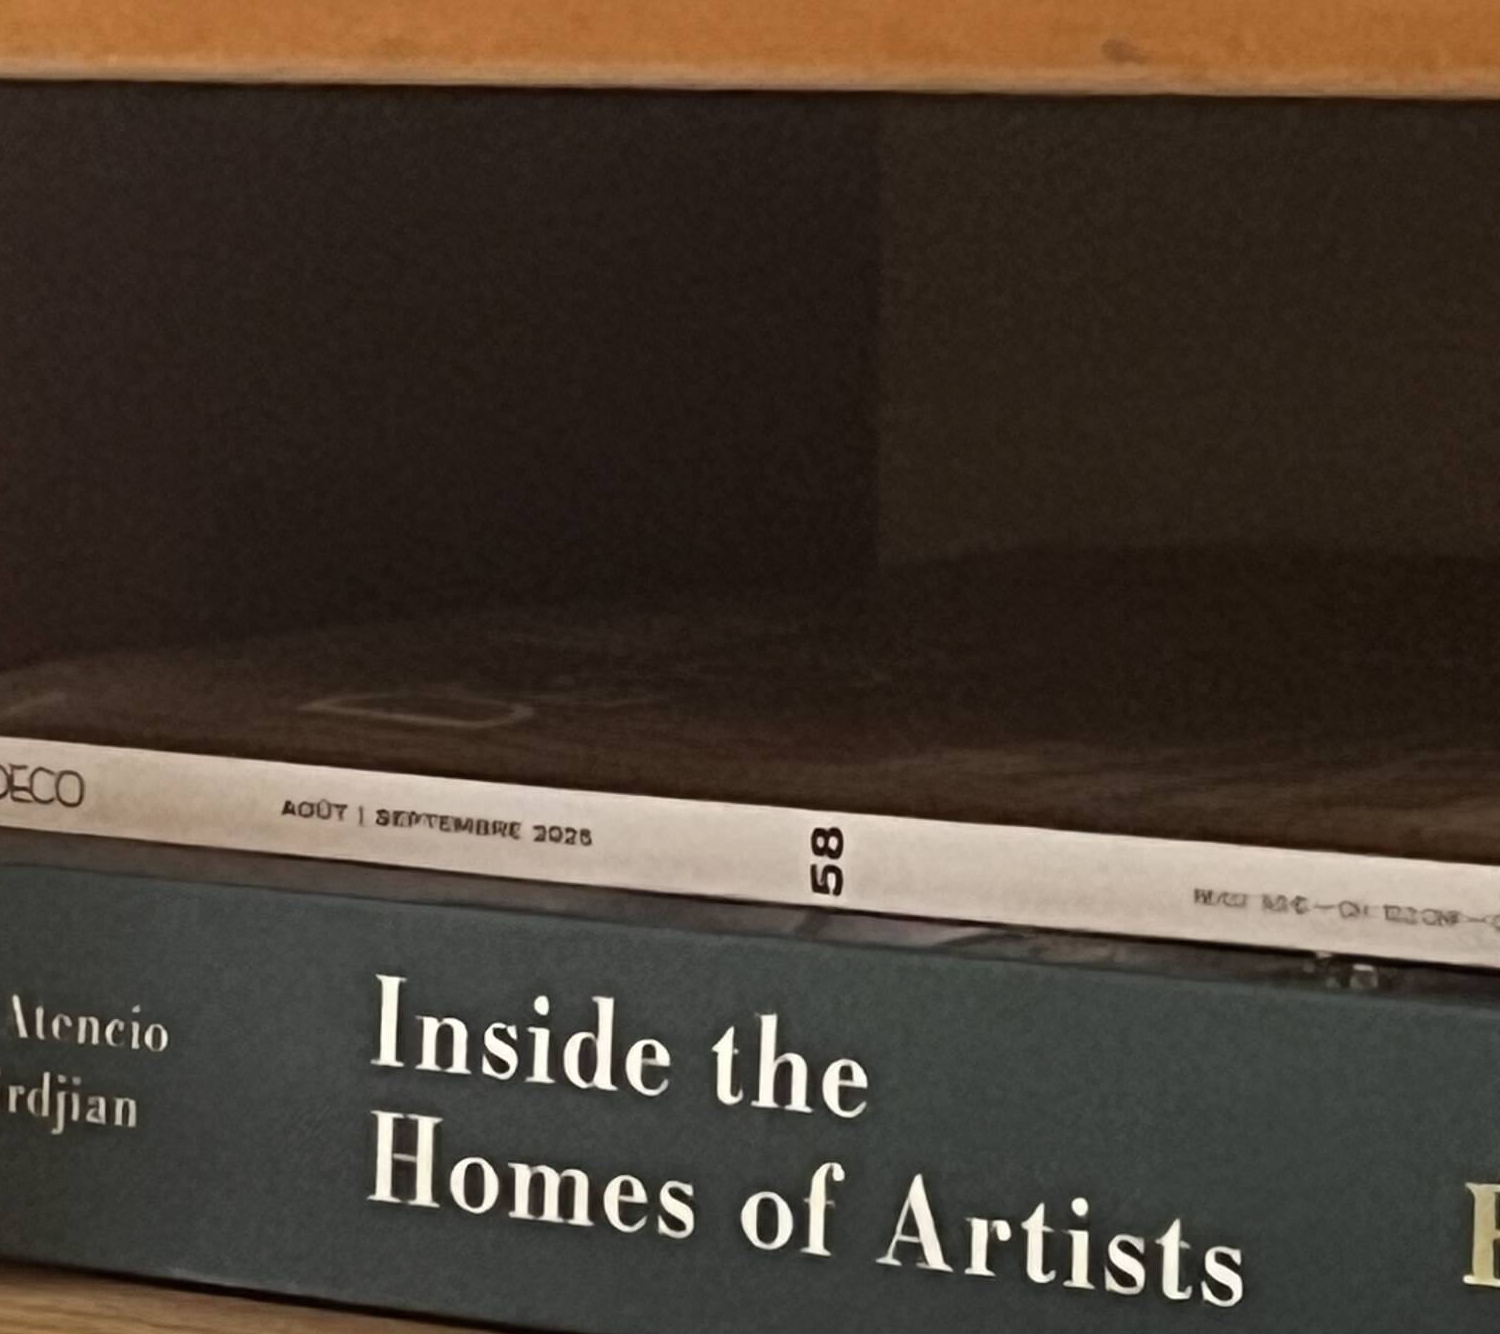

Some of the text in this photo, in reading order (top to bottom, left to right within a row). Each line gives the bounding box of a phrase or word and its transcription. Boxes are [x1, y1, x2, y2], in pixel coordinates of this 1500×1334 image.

[281, 799, 348, 821] AOÛT
[375, 808, 522, 841] SEPTEMBRE
[810, 826, 844, 897] 58
[12, 994, 169, 1052] Atencio
[371, 974, 868, 1118] Inside the
[367, 1110, 1243, 1307] Homes of Artists
